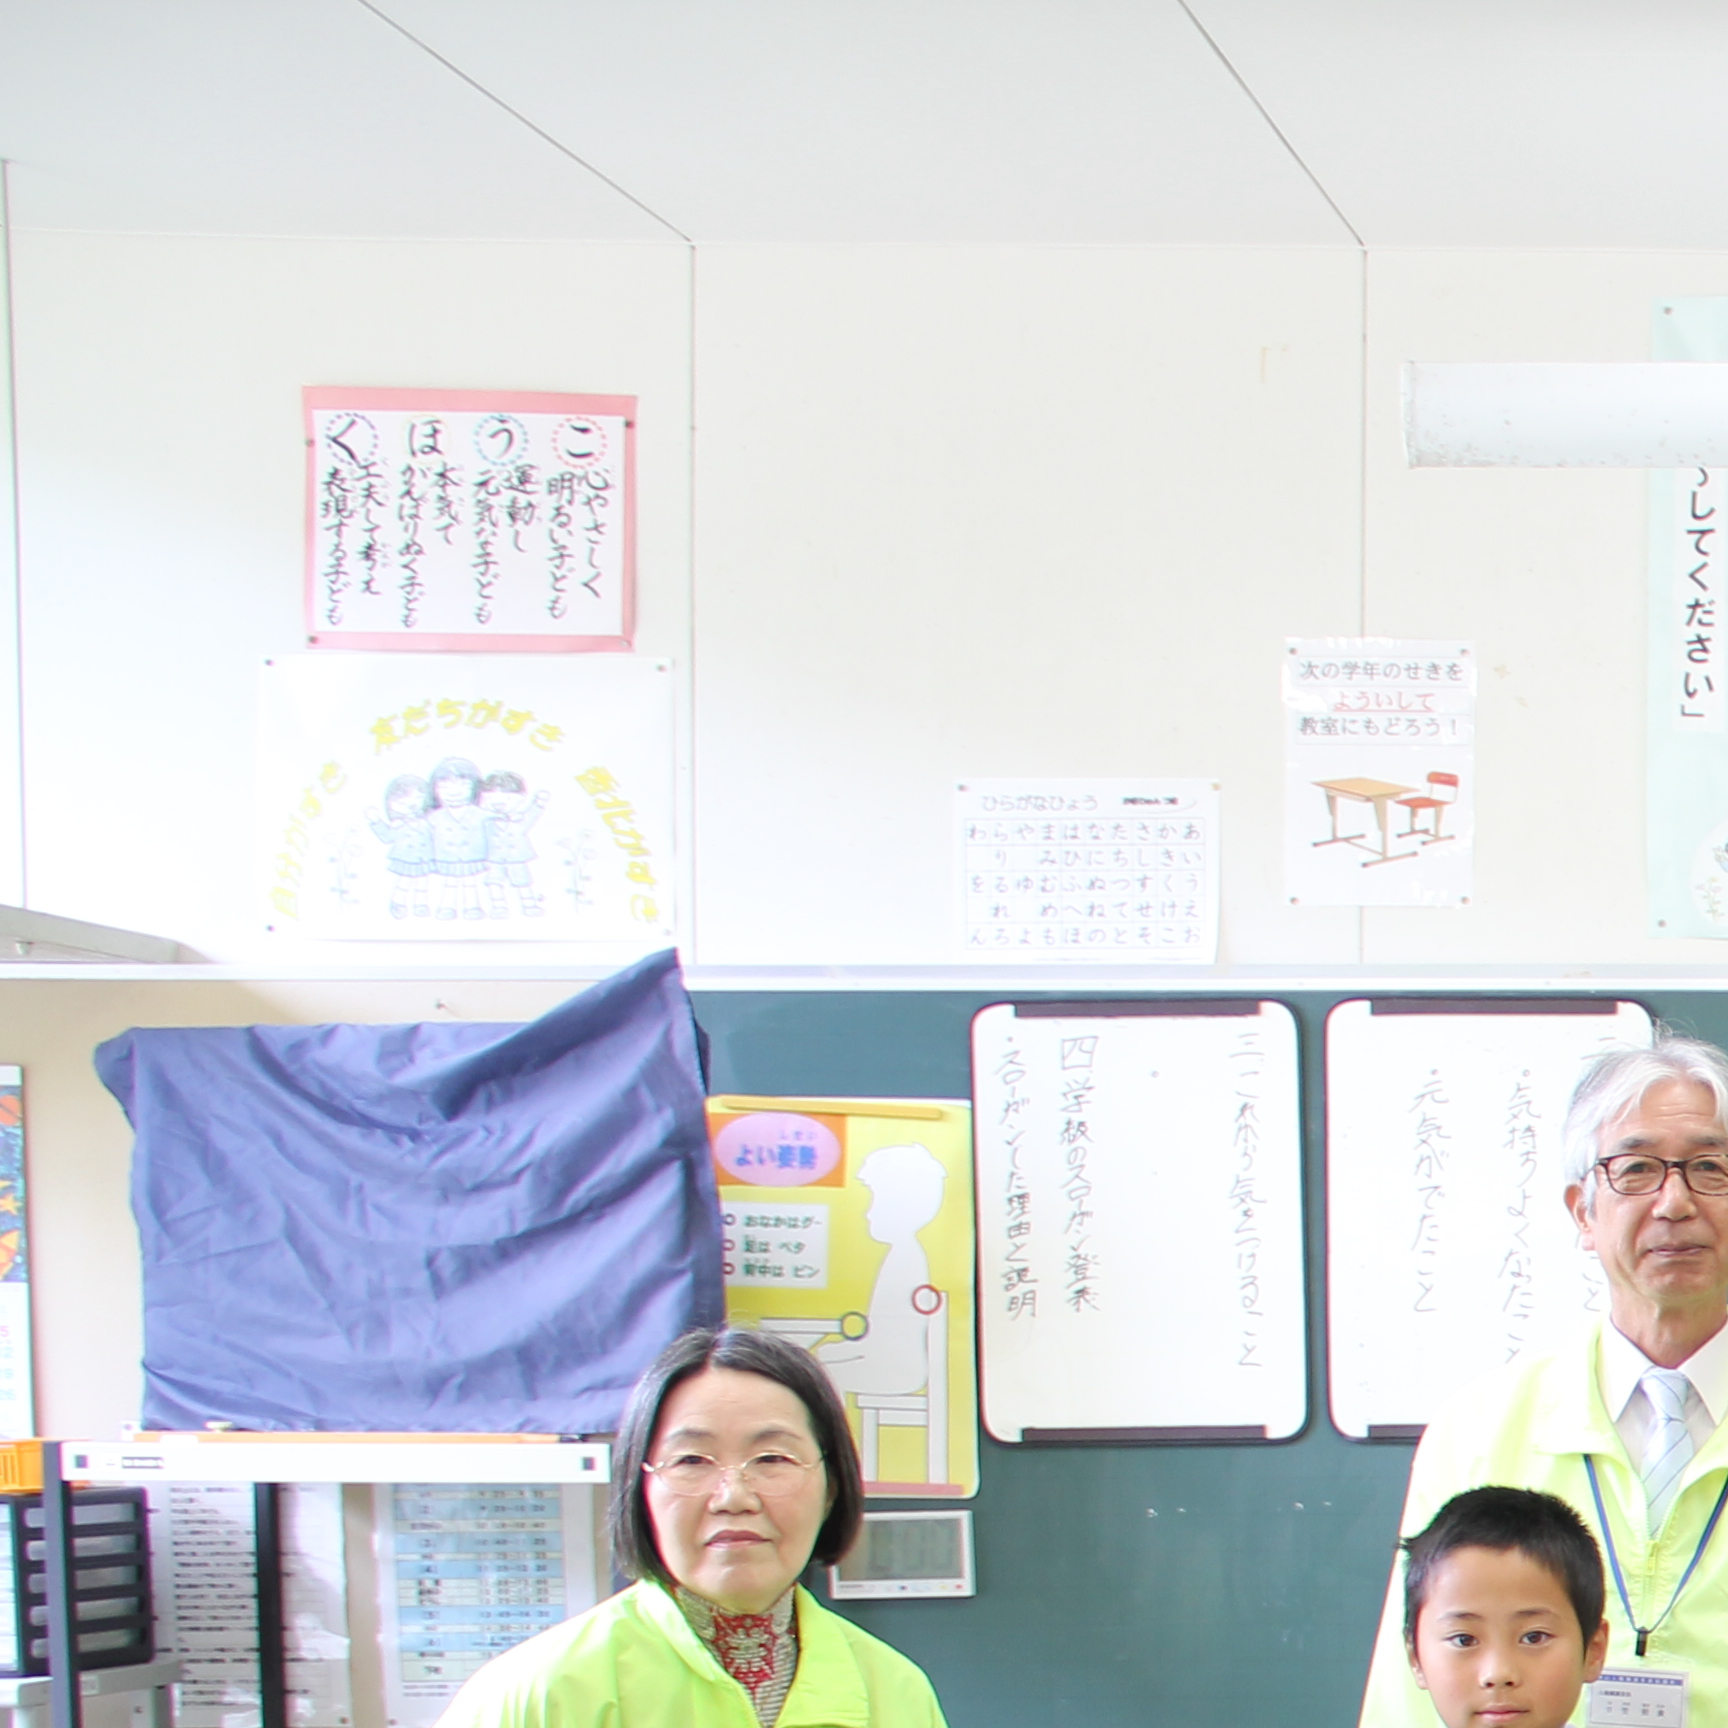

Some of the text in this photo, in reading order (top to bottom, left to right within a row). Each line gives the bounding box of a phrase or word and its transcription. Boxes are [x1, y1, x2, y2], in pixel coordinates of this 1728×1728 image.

[407, 418, 444, 458] ほ
[487, 416, 514, 459] う
[567, 424, 595, 459] こ
[1300, 661, 1464, 681] 次の学年のせきを
[1333, 690, 1436, 711] よういして
